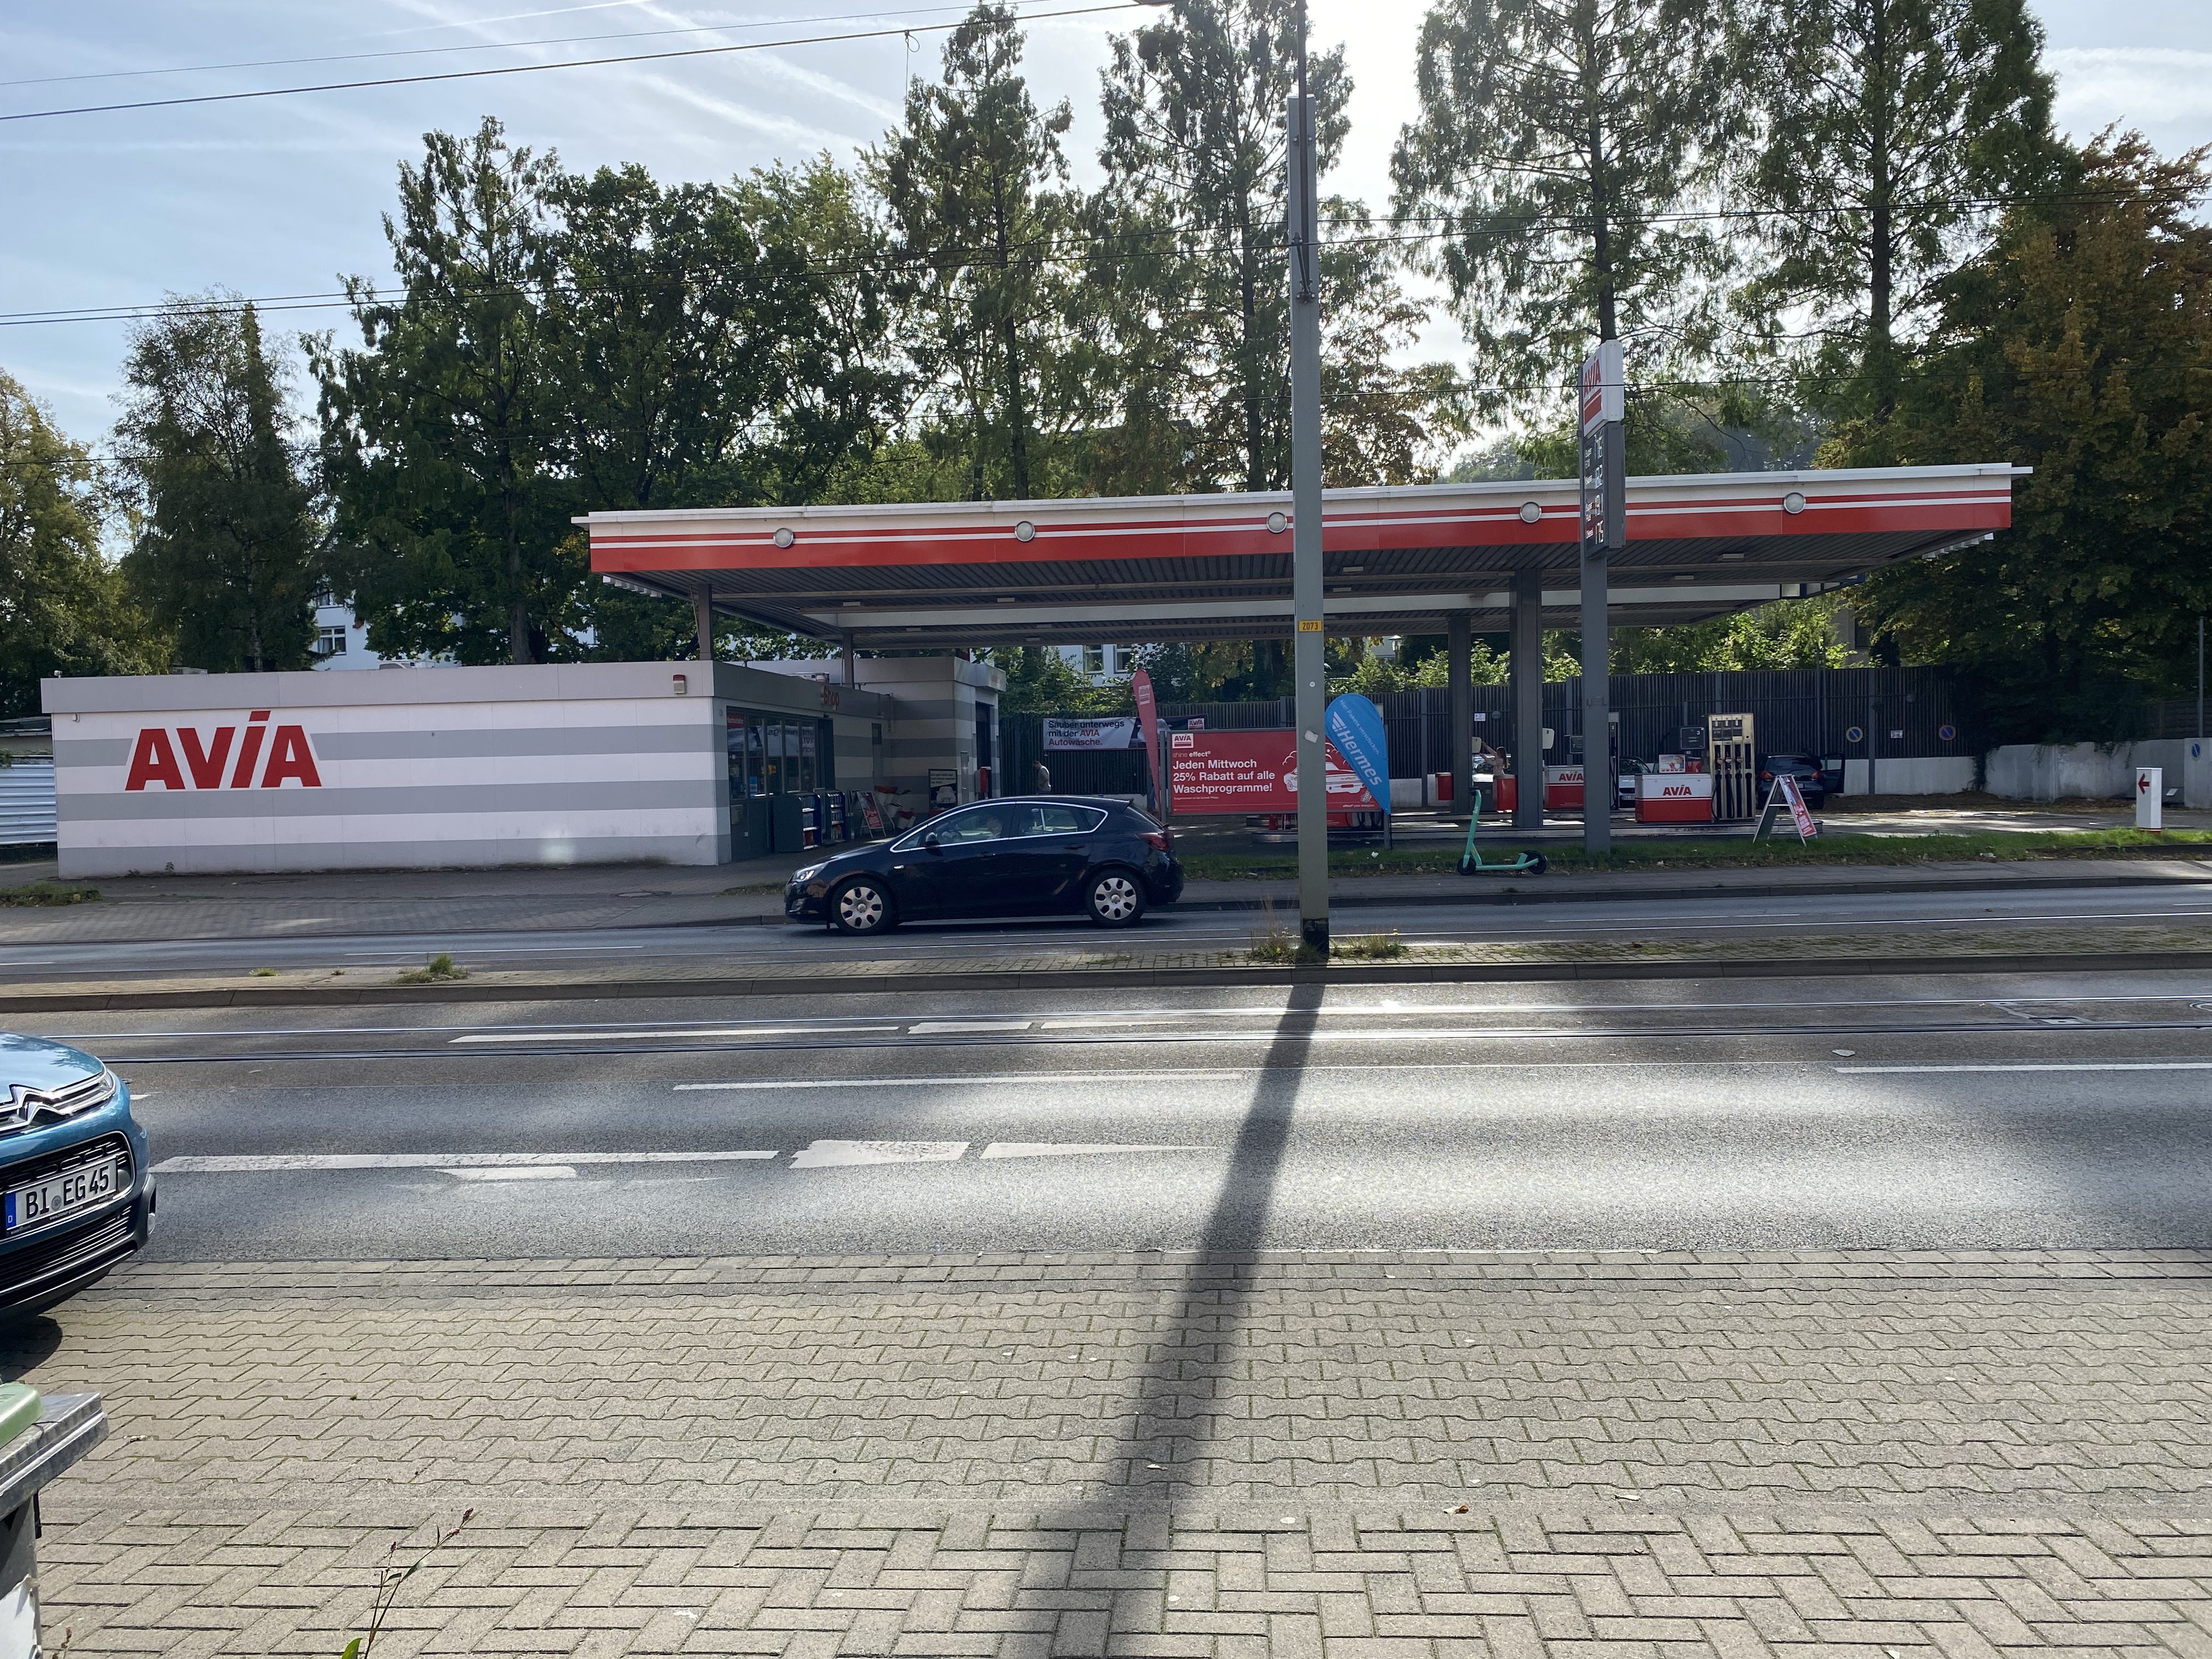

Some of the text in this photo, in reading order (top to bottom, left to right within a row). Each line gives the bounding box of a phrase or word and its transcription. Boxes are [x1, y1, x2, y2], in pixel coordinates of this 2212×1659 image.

[1302, 622, 1318, 630] 2073
[820, 685, 839, 711] Shop
[1080, 721, 1125, 729] unterwegs
[1340, 699, 1380, 755] Hier Pakete verschicken.
[1338, 729, 1383, 786] Hermes
[1173, 759, 1257, 769] Jeden Mittwoch
[1173, 771, 1276, 782] 25% Rabatt auf alle
[1173, 782, 1273, 794] Waschprogramme!
[26, 1187, 49, 1219] BI
[8, 1215, 13, 1223] D
